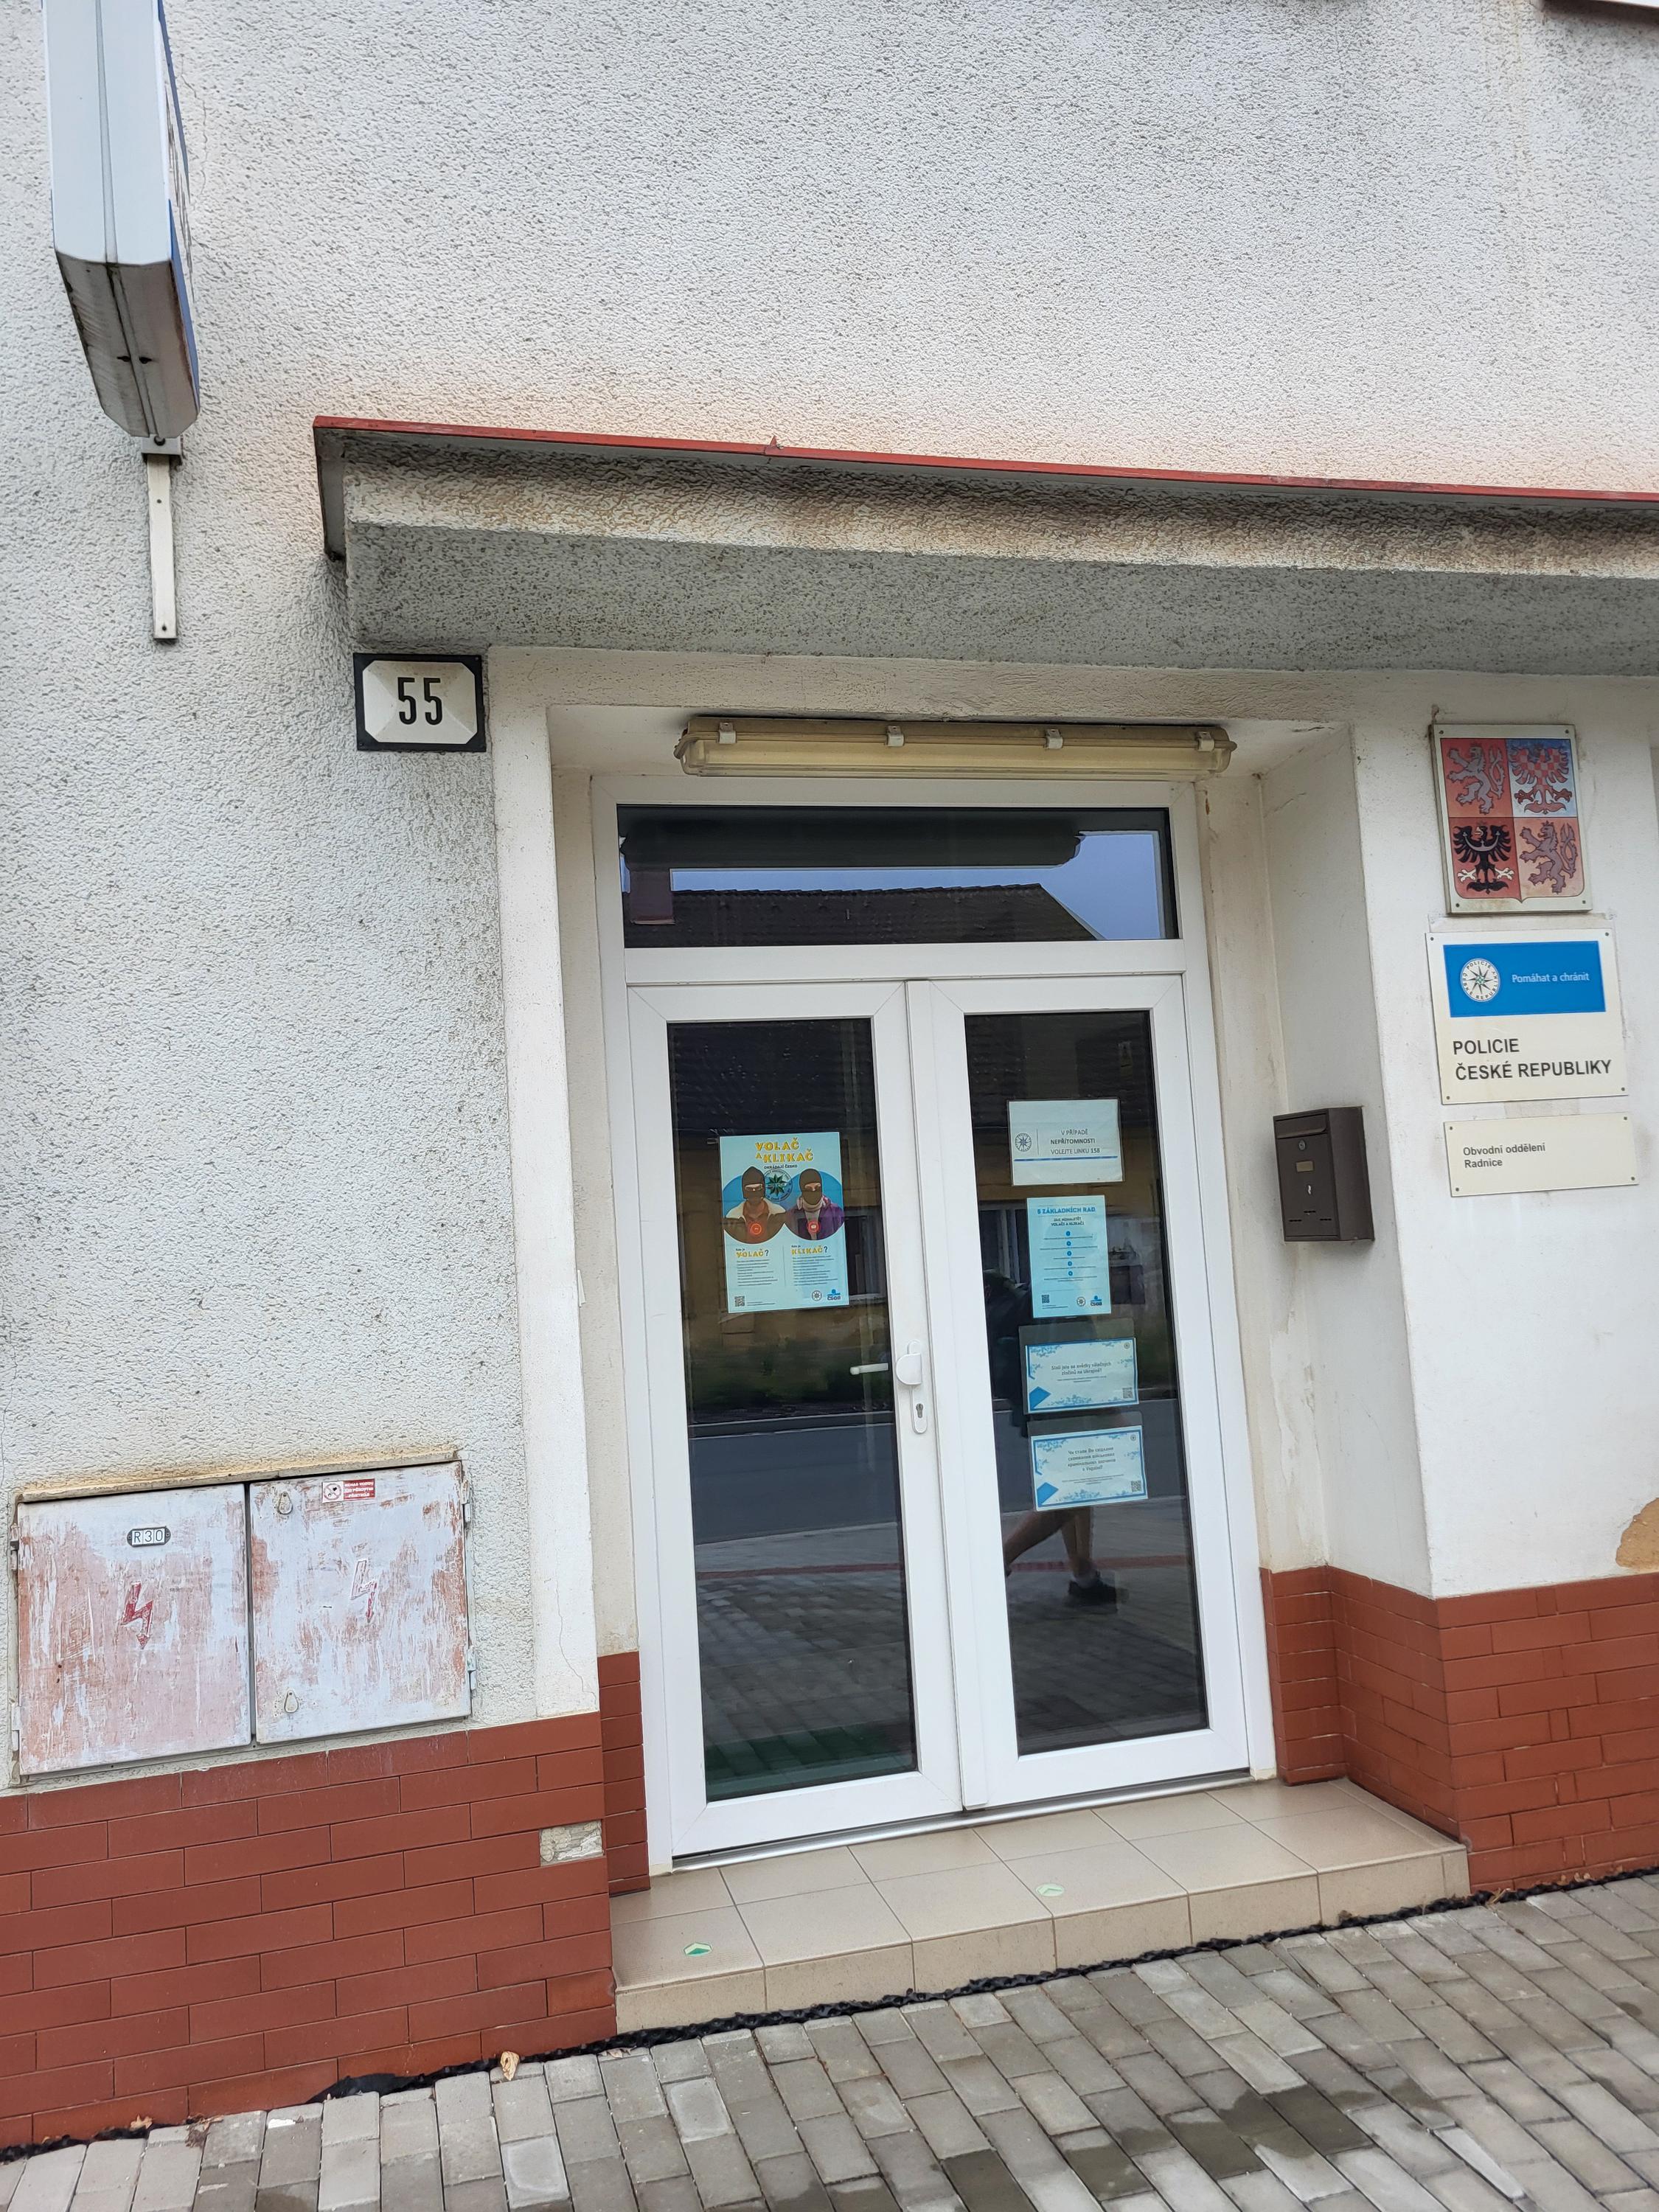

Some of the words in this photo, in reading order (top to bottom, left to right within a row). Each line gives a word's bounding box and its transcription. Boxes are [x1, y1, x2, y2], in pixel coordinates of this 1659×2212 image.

[397, 677, 443, 726] 55
[1466, 961, 1491, 970] POLICIE
[1512, 973, 1551, 983] Pomáhat
[1559, 972, 1590, 981] chránit
[1453, 1038, 1520, 1055] POLICIE
[1455, 1060, 1513, 1081] ČESKÉ
[1517, 1060, 1612, 1078] REPUBLIKY
[755, 1137, 800, 1151] VOLAČ
[1050, 1137, 1096, 1145] NEPŘÍTOMNOSTI
[763, 1148, 814, 1164] KLIKAČ
[1463, 1144, 1503, 1156] Obvodní
[1505, 1142, 1546, 1153] oddělení
[1464, 1158, 1503, 1169] Radnice
[1042, 1206, 1082, 1214] ZÁKLADNÍCH
[133, 1529, 163, 1543] R30
